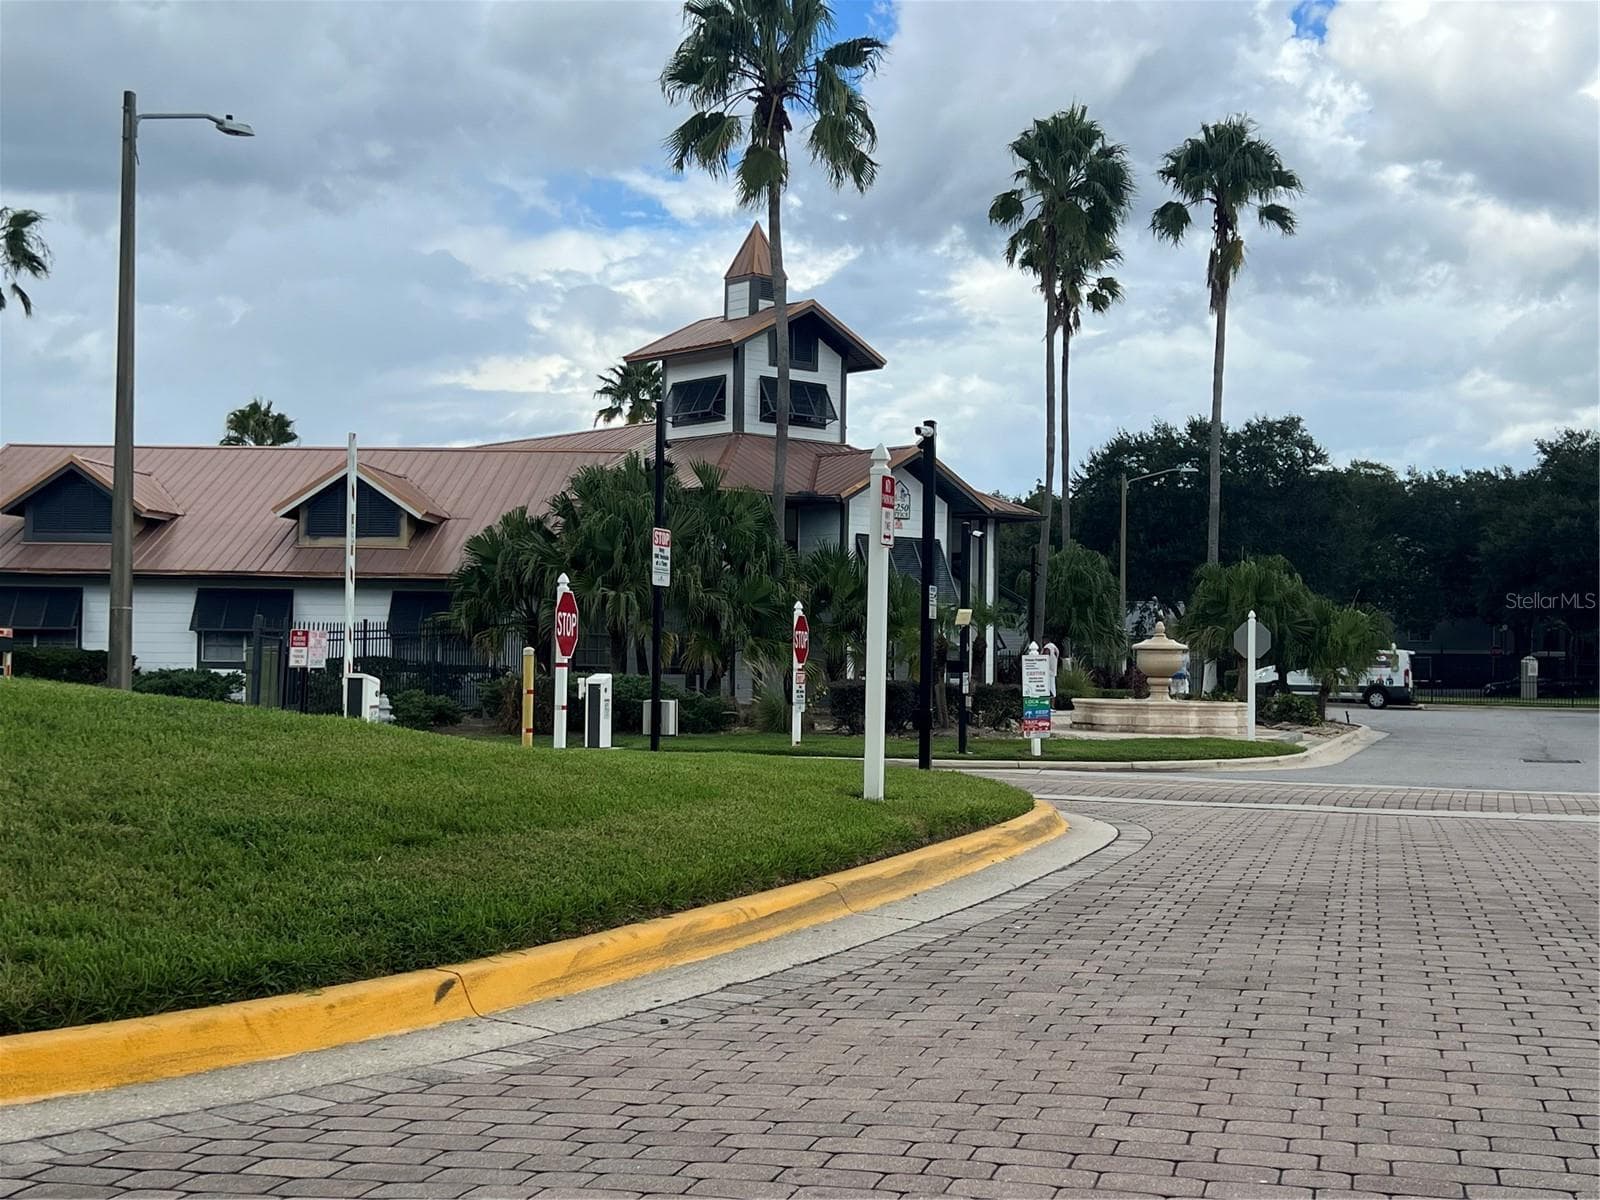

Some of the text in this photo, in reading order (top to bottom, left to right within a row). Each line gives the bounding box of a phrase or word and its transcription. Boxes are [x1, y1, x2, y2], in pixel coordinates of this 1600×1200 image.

[655, 530, 670, 546] STOP
[557, 612, 577, 637] STOP
[795, 630, 807, 649] STOP
